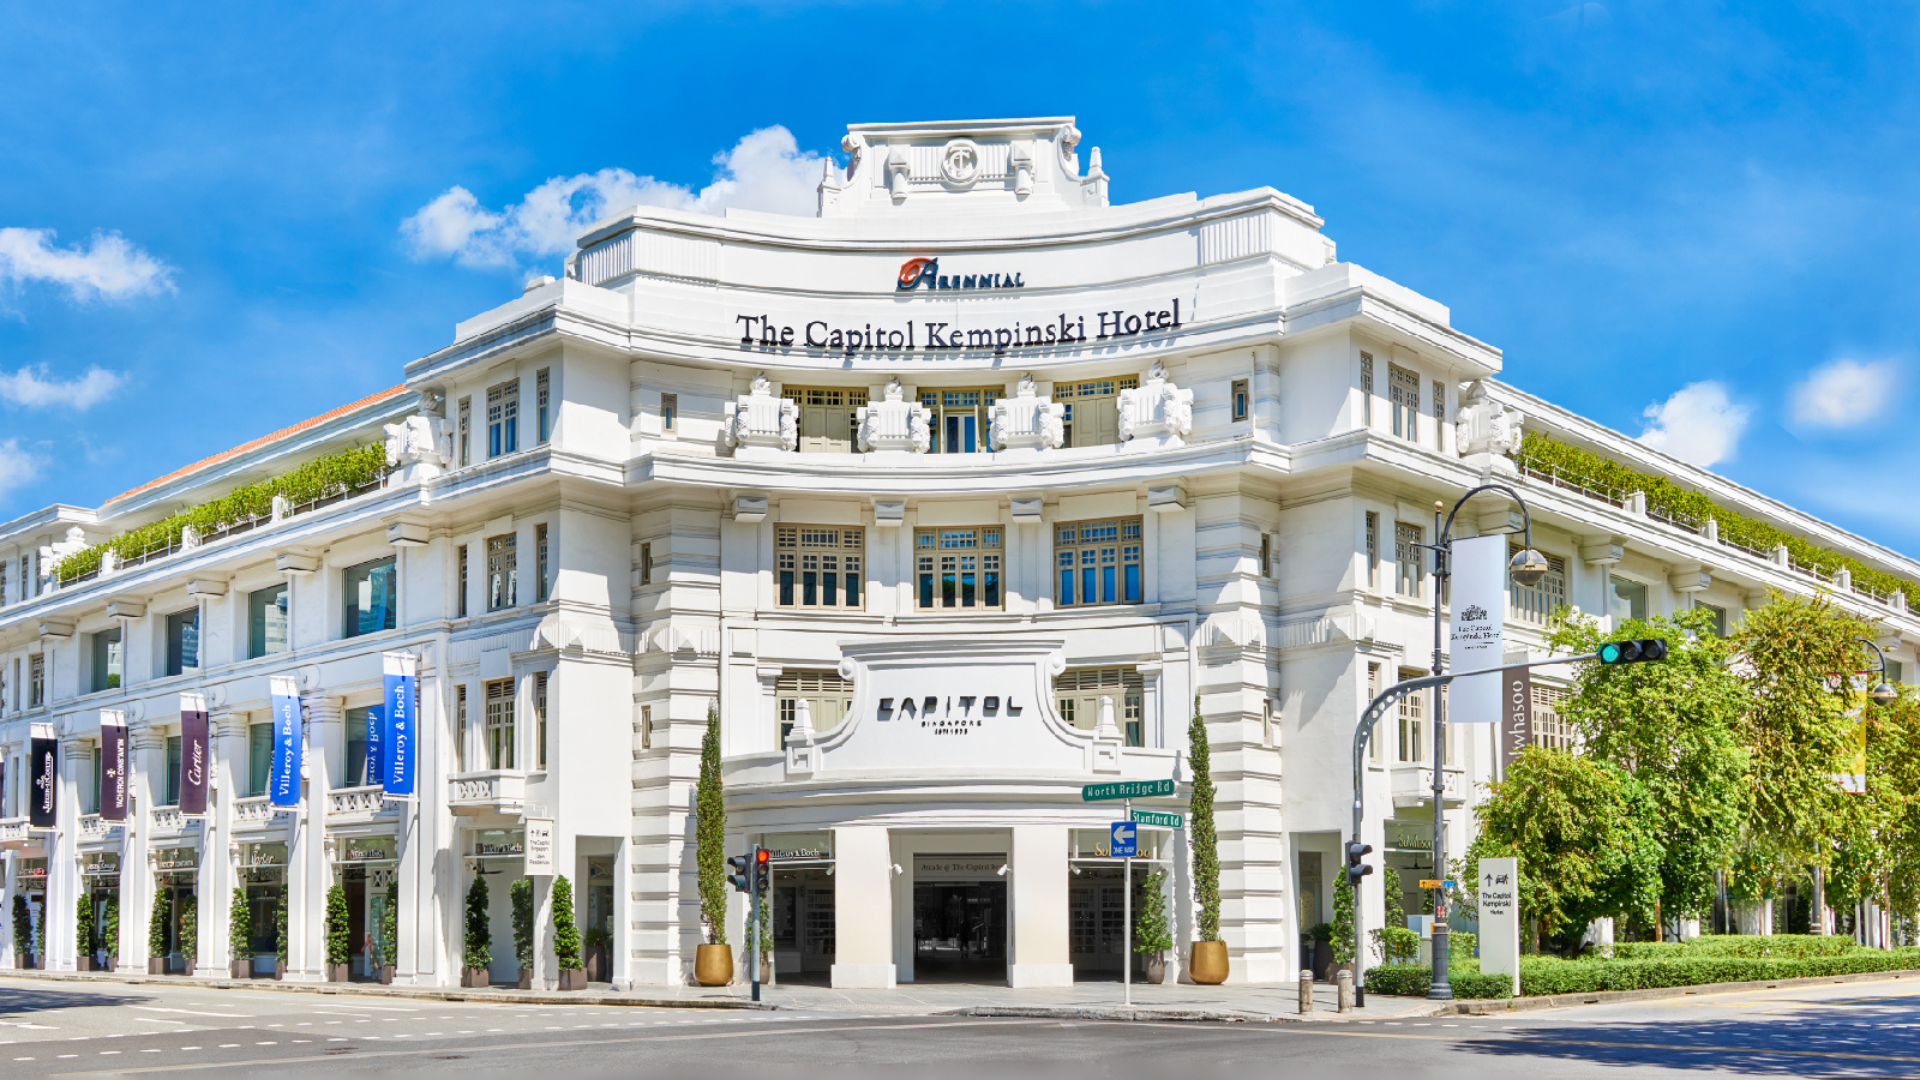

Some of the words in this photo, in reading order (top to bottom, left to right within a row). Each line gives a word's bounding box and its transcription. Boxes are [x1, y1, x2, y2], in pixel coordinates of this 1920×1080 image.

[898, 257, 1025, 289] PERENNIAL
[736, 313, 794, 346] The
[805, 319, 915, 356] Capitol
[925, 312, 1087, 355] Kempinski
[1097, 297, 1182, 339] Hotel
[394, 685, 405, 719] Boch
[879, 695, 1023, 712] CAPITOL
[281, 704, 292, 736] Boch
[395, 721, 405, 731] &
[284, 737, 293, 747] &
[188, 739, 203, 786] Cartier
[392, 732, 408, 785] Villeroy
[279, 747, 294, 796] Villeroy
[1087, 785, 1115, 797] North
[1120, 782, 1153, 796] Bridge
[1157, 780, 1170, 793] Rd
[1170, 815, 1180, 827] Rd
[952, 863, 964, 871] The
[966, 863, 989, 873] Capitol
[1493, 892, 1512, 900] Capitol
